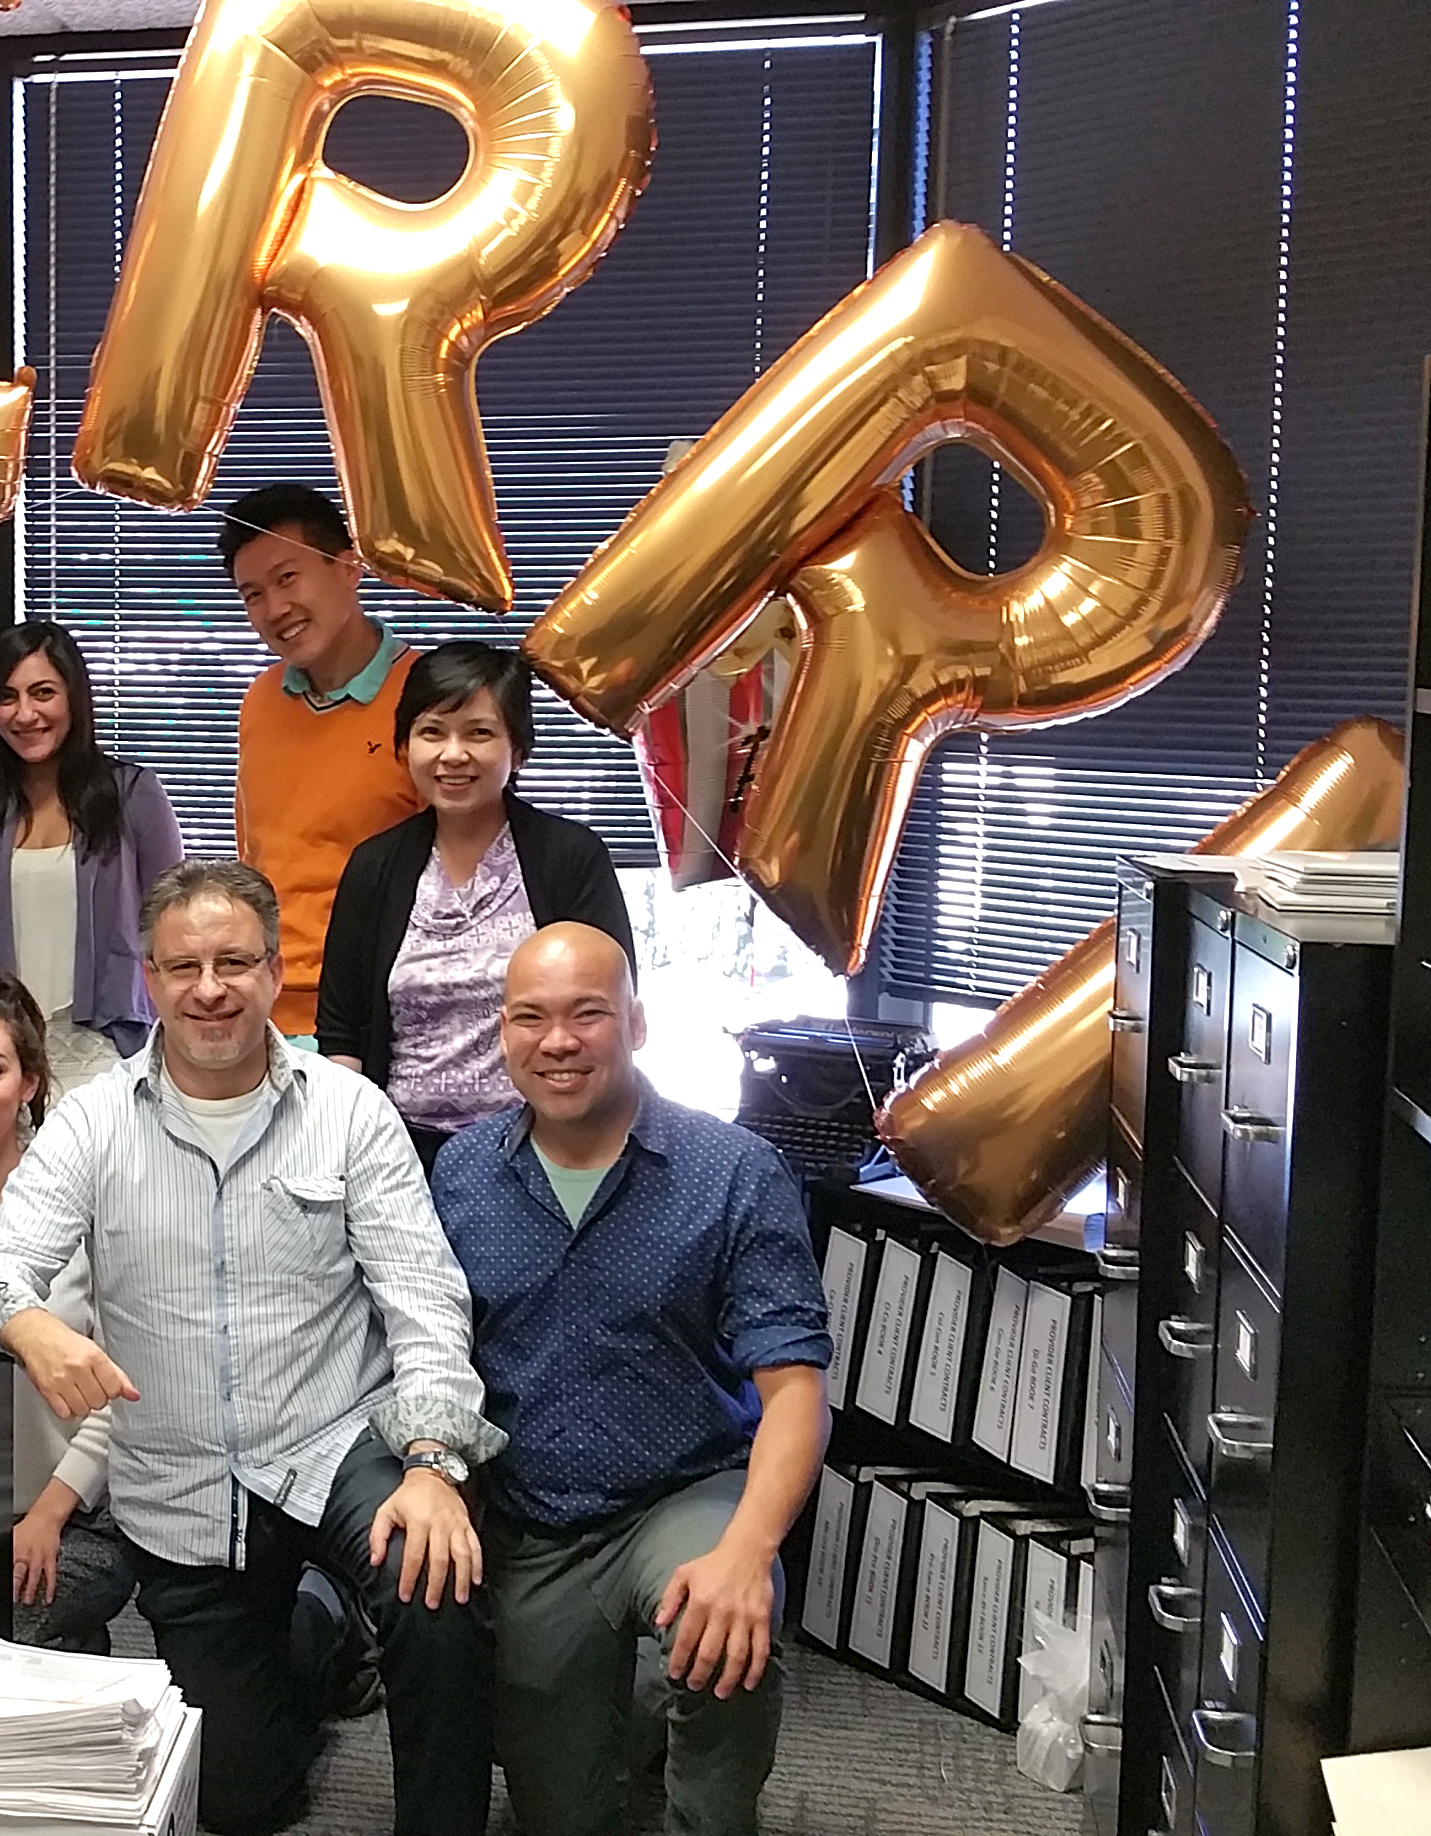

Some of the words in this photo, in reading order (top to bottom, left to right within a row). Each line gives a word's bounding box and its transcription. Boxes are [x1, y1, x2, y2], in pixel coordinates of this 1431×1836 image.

[842, 1261, 853, 1304] PROVIDER
[896, 1274, 909, 1317] PROVIDER
[838, 1303, 847, 1332] CLIENT
[892, 1317, 902, 1346] CLIENT
[949, 1288, 961, 1333] PROVIDER
[1008, 1302, 1019, 1349] PROVIDER
[831, 1332, 843, 1381] CONTRACTS
[877, 1323, 887, 1348] BOOK
[929, 1343, 939, 1370] BOOK
[945, 1332, 955, 1362] CLIENT
[1045, 1318, 1058, 1366] PROVIDER
[883, 1346, 897, 1395] CONTRACTS
[990, 1358, 999, 1385] BOOK
[1003, 1348, 1013, 1378] CLIENT
[1042, 1365, 1053, 1397] CLIENT
[938, 1362, 951, 1413] CONTRACTS
[996, 1378, 1009, 1431] CONTRACTS
[1026, 1402, 1034, 1410] 7
[1027, 1374, 1037, 1402] BOOK
[1037, 1397, 1050, 1451] CONTRACTS
[885, 1517, 896, 1561] PROVIDER
[939, 1536, 948, 1581] PROVIDER
[881, 1560, 891, 1590] CLIENT
[936, 1580, 944, 1611] CLIENT
[993, 1557, 1002, 1604] PROVIDER
[875, 1589, 887, 1639] CONTRACTS
[990, 1603, 998, 1634] CLIENT
[1045, 1577, 1055, 1618] PROVIDE
[931, 1610, 942, 1661] CONTRACTS
[985, 1633, 996, 1686] CONTRACTS
